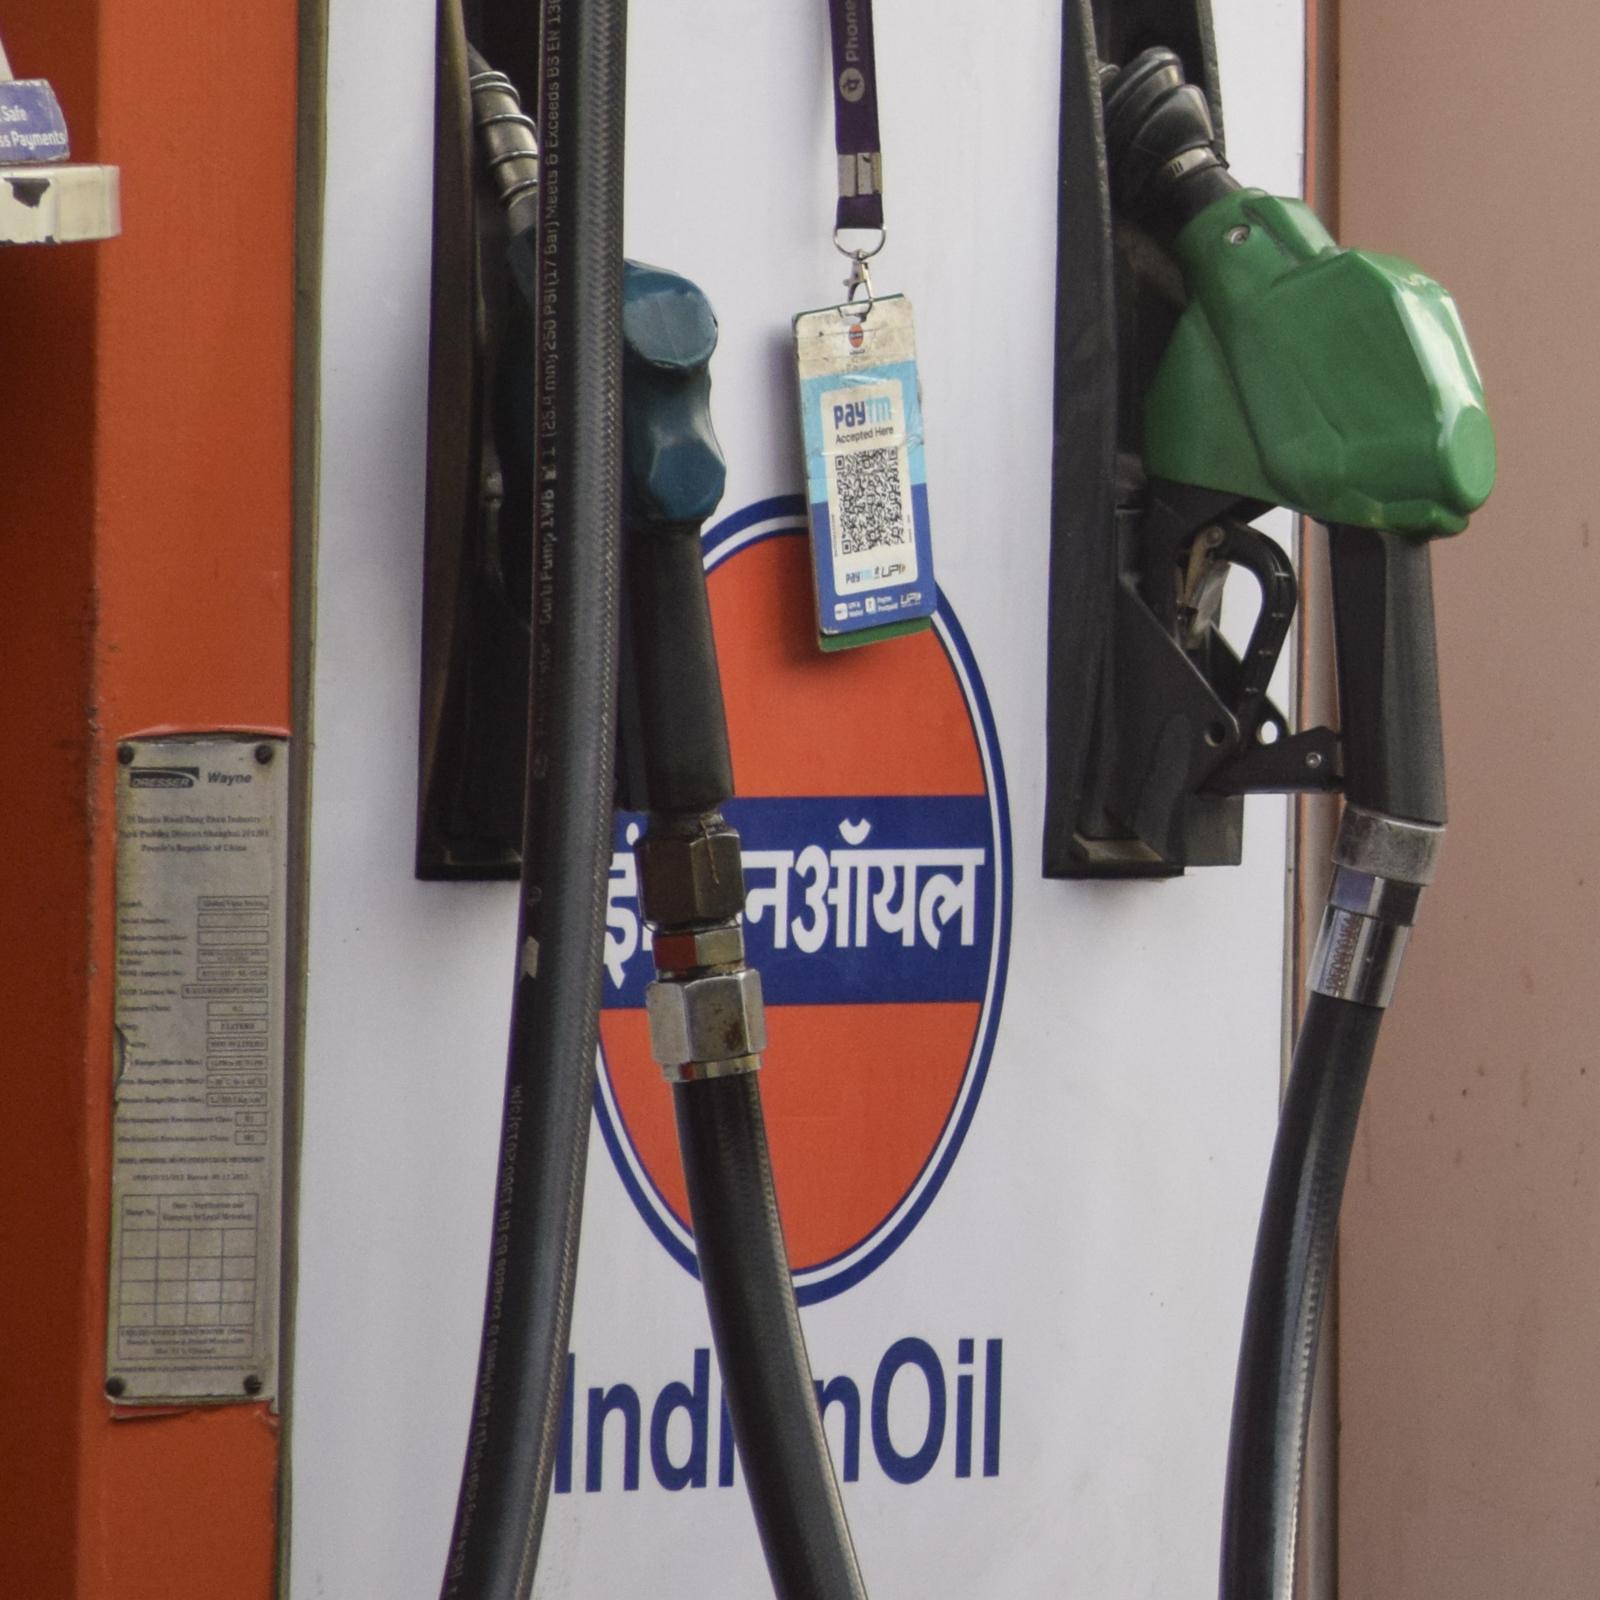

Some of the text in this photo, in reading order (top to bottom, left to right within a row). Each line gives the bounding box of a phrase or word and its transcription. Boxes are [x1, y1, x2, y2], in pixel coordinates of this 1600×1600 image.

[546, 81, 560, 148] Exceeds
[11, 130, 67, 151] Payments
[543, 319, 557, 352] 250
[834, 424, 895, 446] Accepted Here
[207, 771, 252, 786] Wayne
[553, 1336, 1003, 1494] IndinOil
